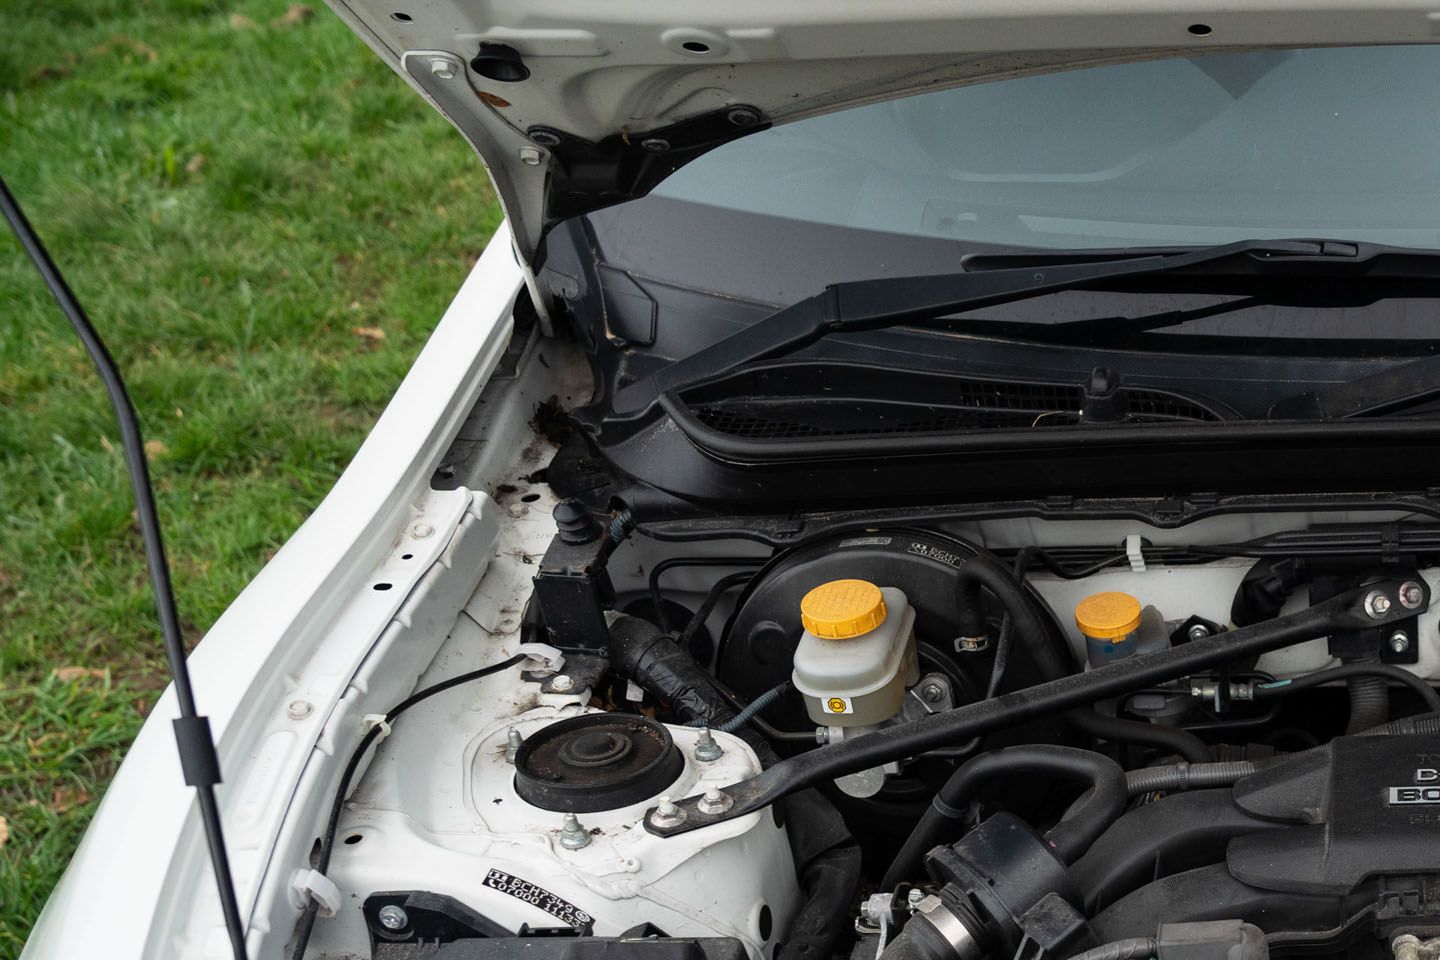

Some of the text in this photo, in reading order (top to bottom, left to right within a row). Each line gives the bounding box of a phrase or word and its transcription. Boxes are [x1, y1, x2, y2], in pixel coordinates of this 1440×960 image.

[497, 880, 586, 929] 07000 11133
[511, 878, 574, 914] BCH7349
